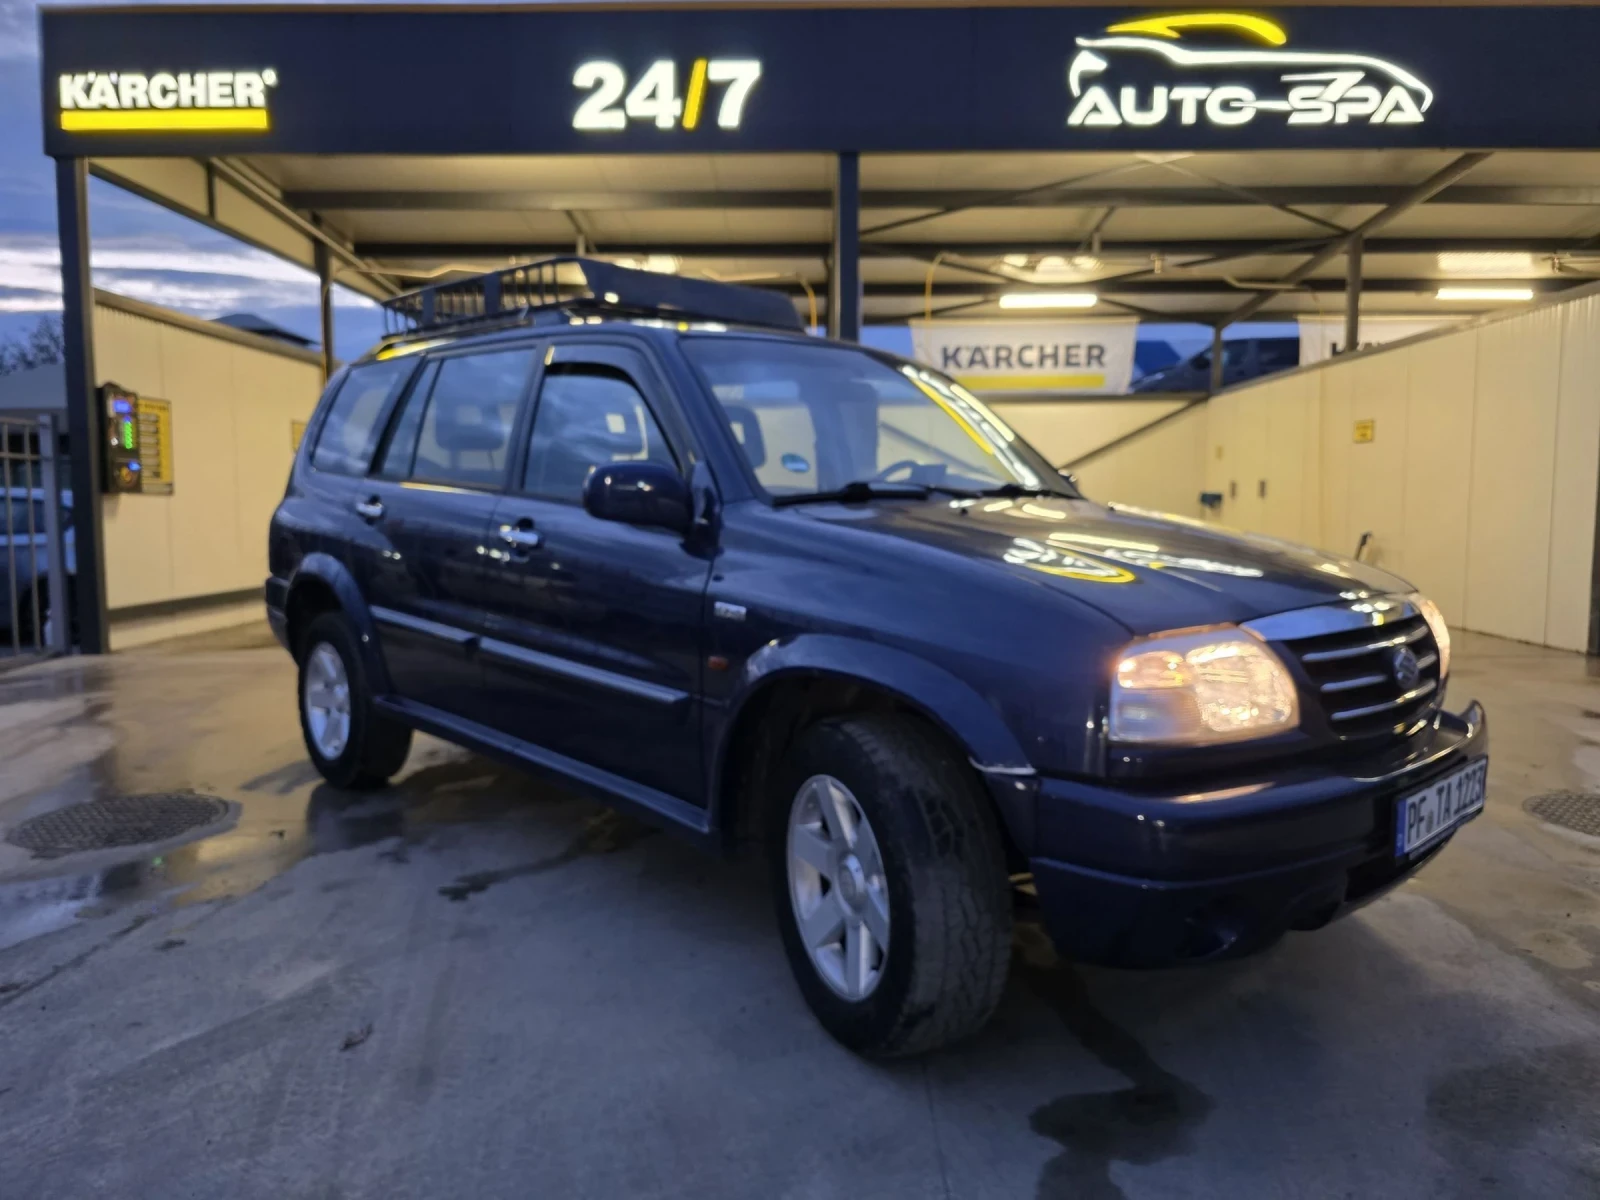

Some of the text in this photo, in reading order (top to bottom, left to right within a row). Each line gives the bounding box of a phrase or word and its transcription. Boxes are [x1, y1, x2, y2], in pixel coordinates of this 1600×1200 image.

[572, 58, 761, 130] 24/7
[940, 343, 1107, 369] KÄRCHER
[1407, 796, 1427, 844] PF
[1436, 782, 1452, 826] TA
